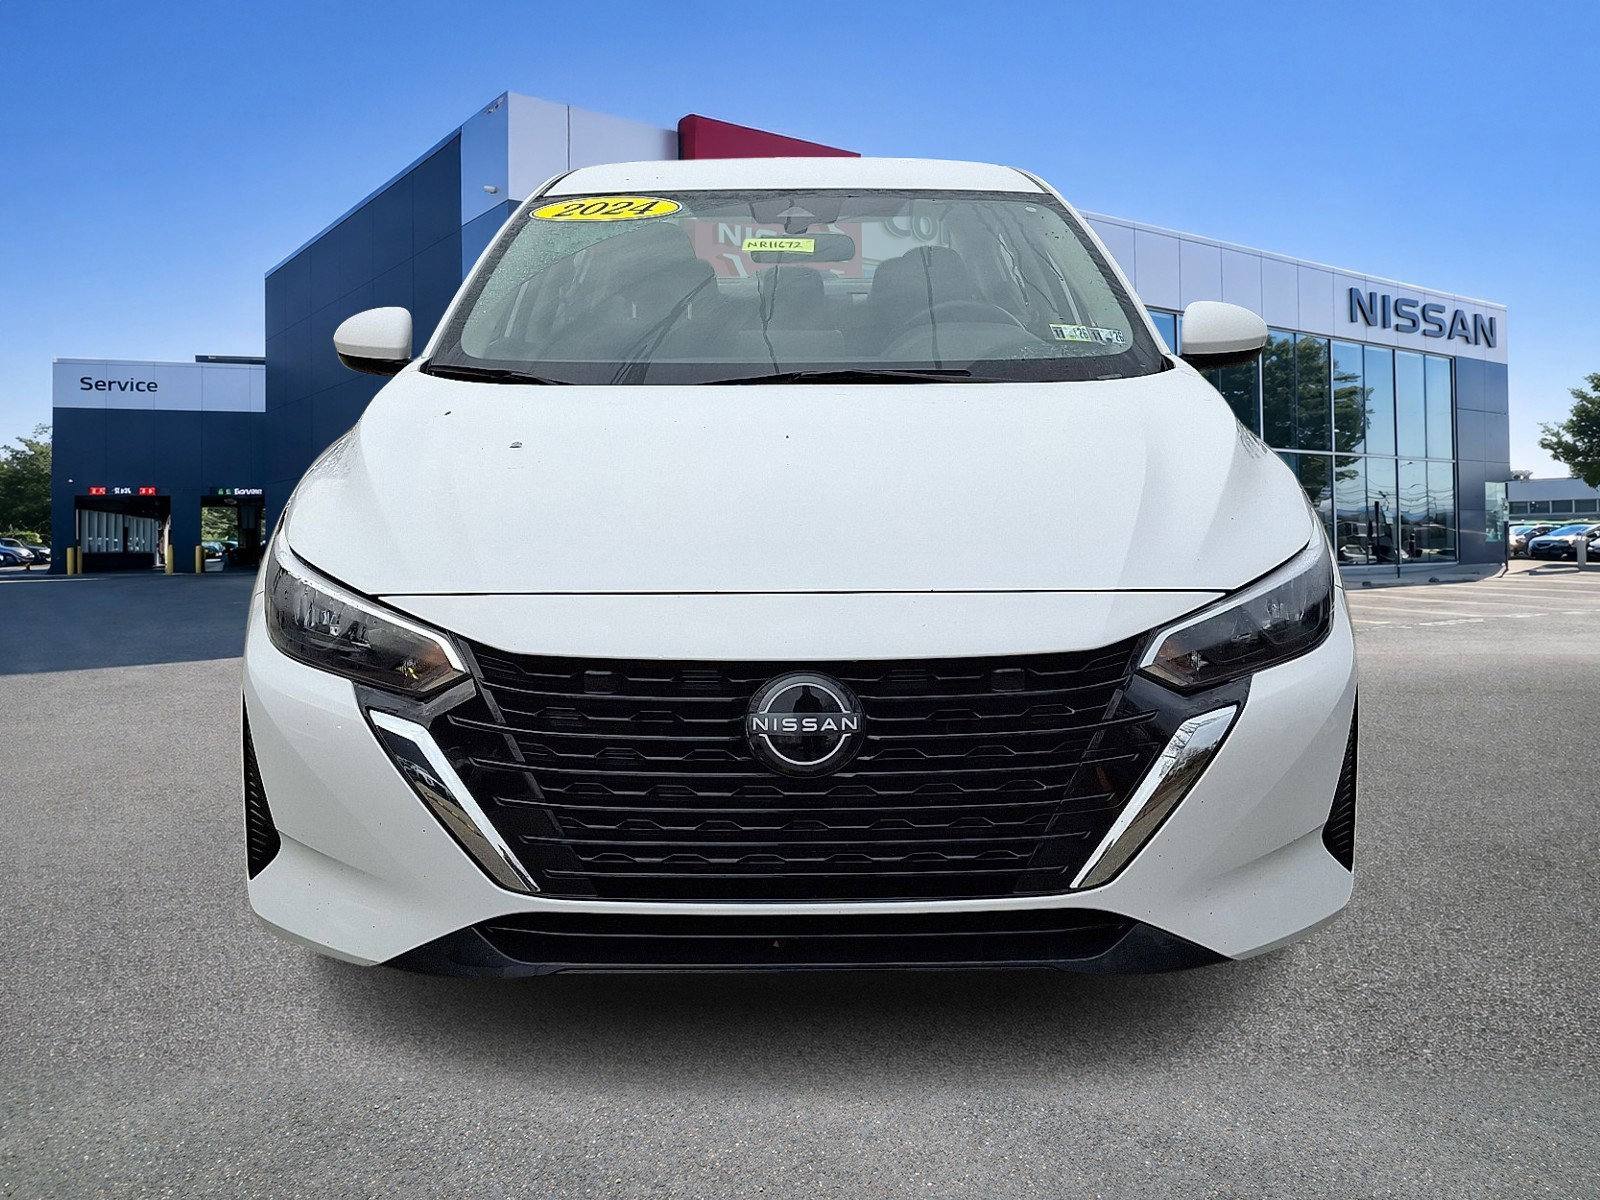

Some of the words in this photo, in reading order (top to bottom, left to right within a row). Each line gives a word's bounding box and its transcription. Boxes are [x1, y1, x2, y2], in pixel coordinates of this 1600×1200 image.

[552, 200, 660, 217] 2024
[1349, 287, 1497, 348] NISSAN
[79, 376, 158, 392] Service
[752, 717, 858, 732] NISSAN
